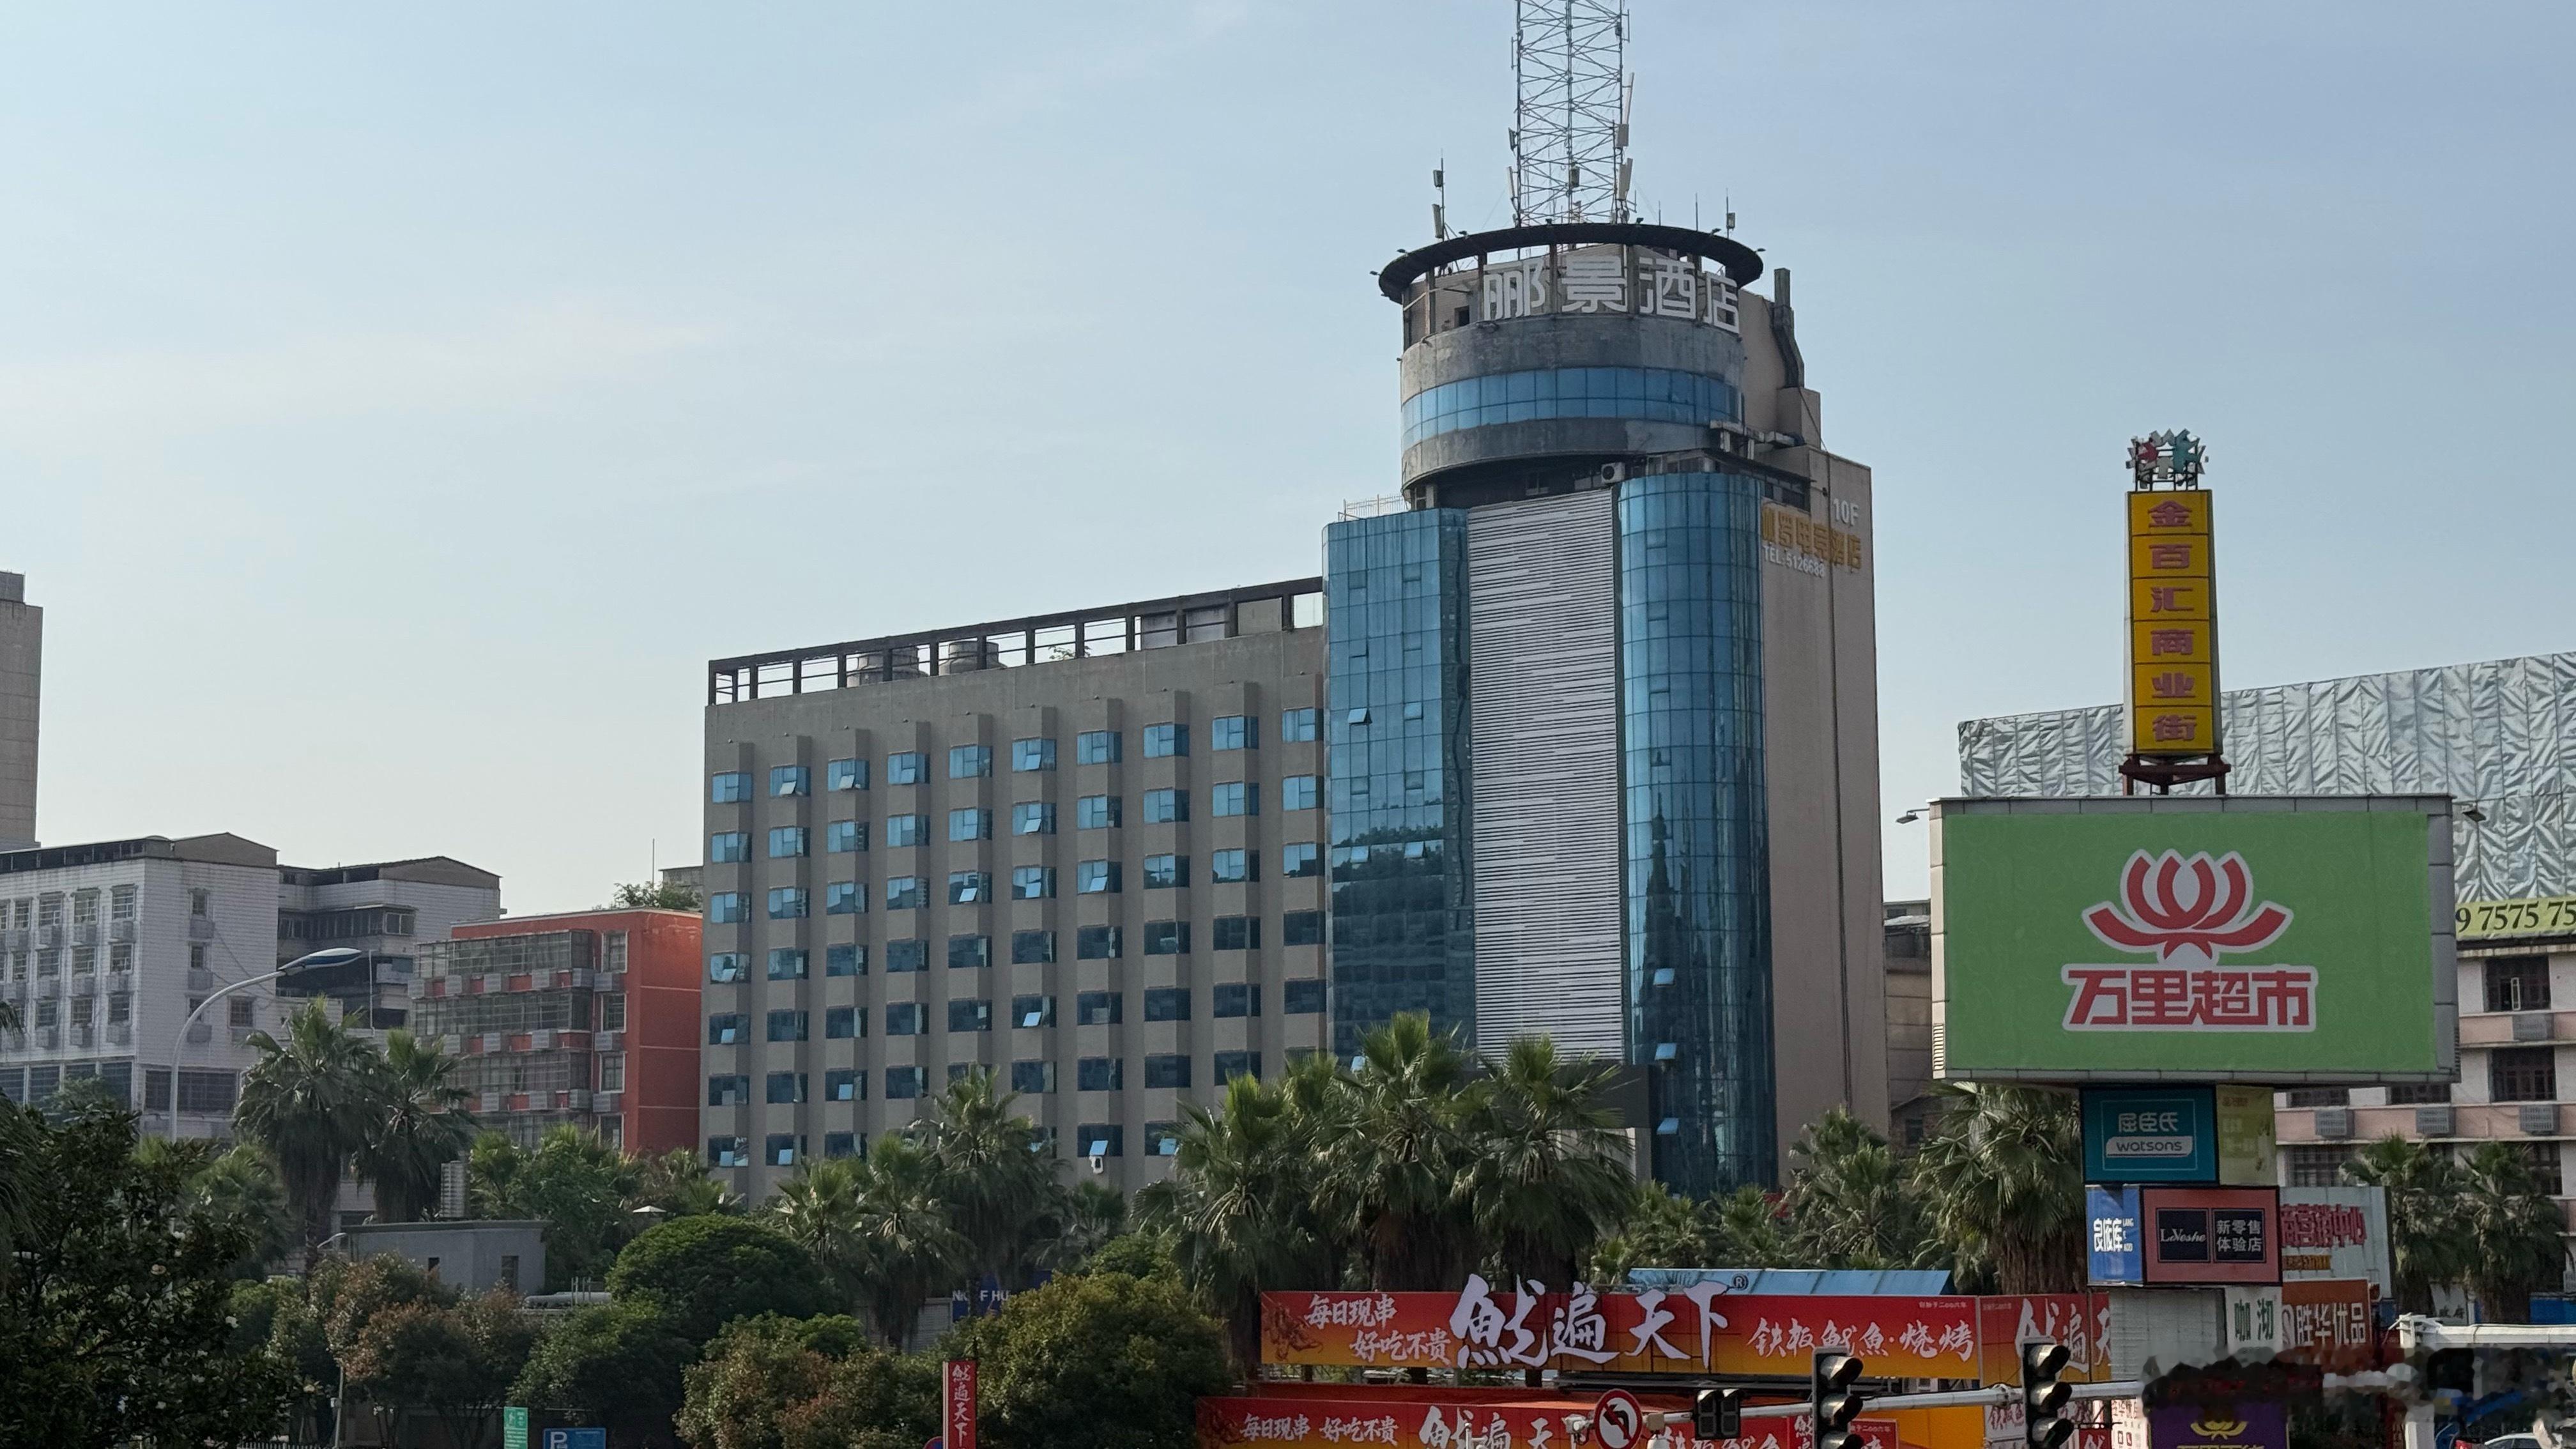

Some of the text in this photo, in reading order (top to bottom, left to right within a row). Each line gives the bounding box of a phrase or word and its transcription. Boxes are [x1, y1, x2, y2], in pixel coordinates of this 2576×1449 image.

[1483, 256, 1740, 334] 郦景酒店
[1833, 498, 1859, 526] 10F
[2148, 500, 2197, 742] 金百汇商业街
[2478, 901, 2540, 931] 7575
[2547, 900, 2576, 926] 75
[2068, 969, 2312, 1026] 万里超市
[2119, 1112, 2178, 1133] 屈臣氏
[2116, 1140, 2182, 1152] watsons
[2216, 1220, 2262, 1234] 新零售
[2216, 1236, 2262, 1252] 体验店
[1304, 1294, 1398, 1330] 每日现串
[2296, 1302, 2366, 1346] 胜华优品
[1349, 1327, 1452, 1367] 好吃不贵
[1240, 1413, 1312, 1443] 每日现串
[1319, 1415, 1399, 1447] 好吃不贵
